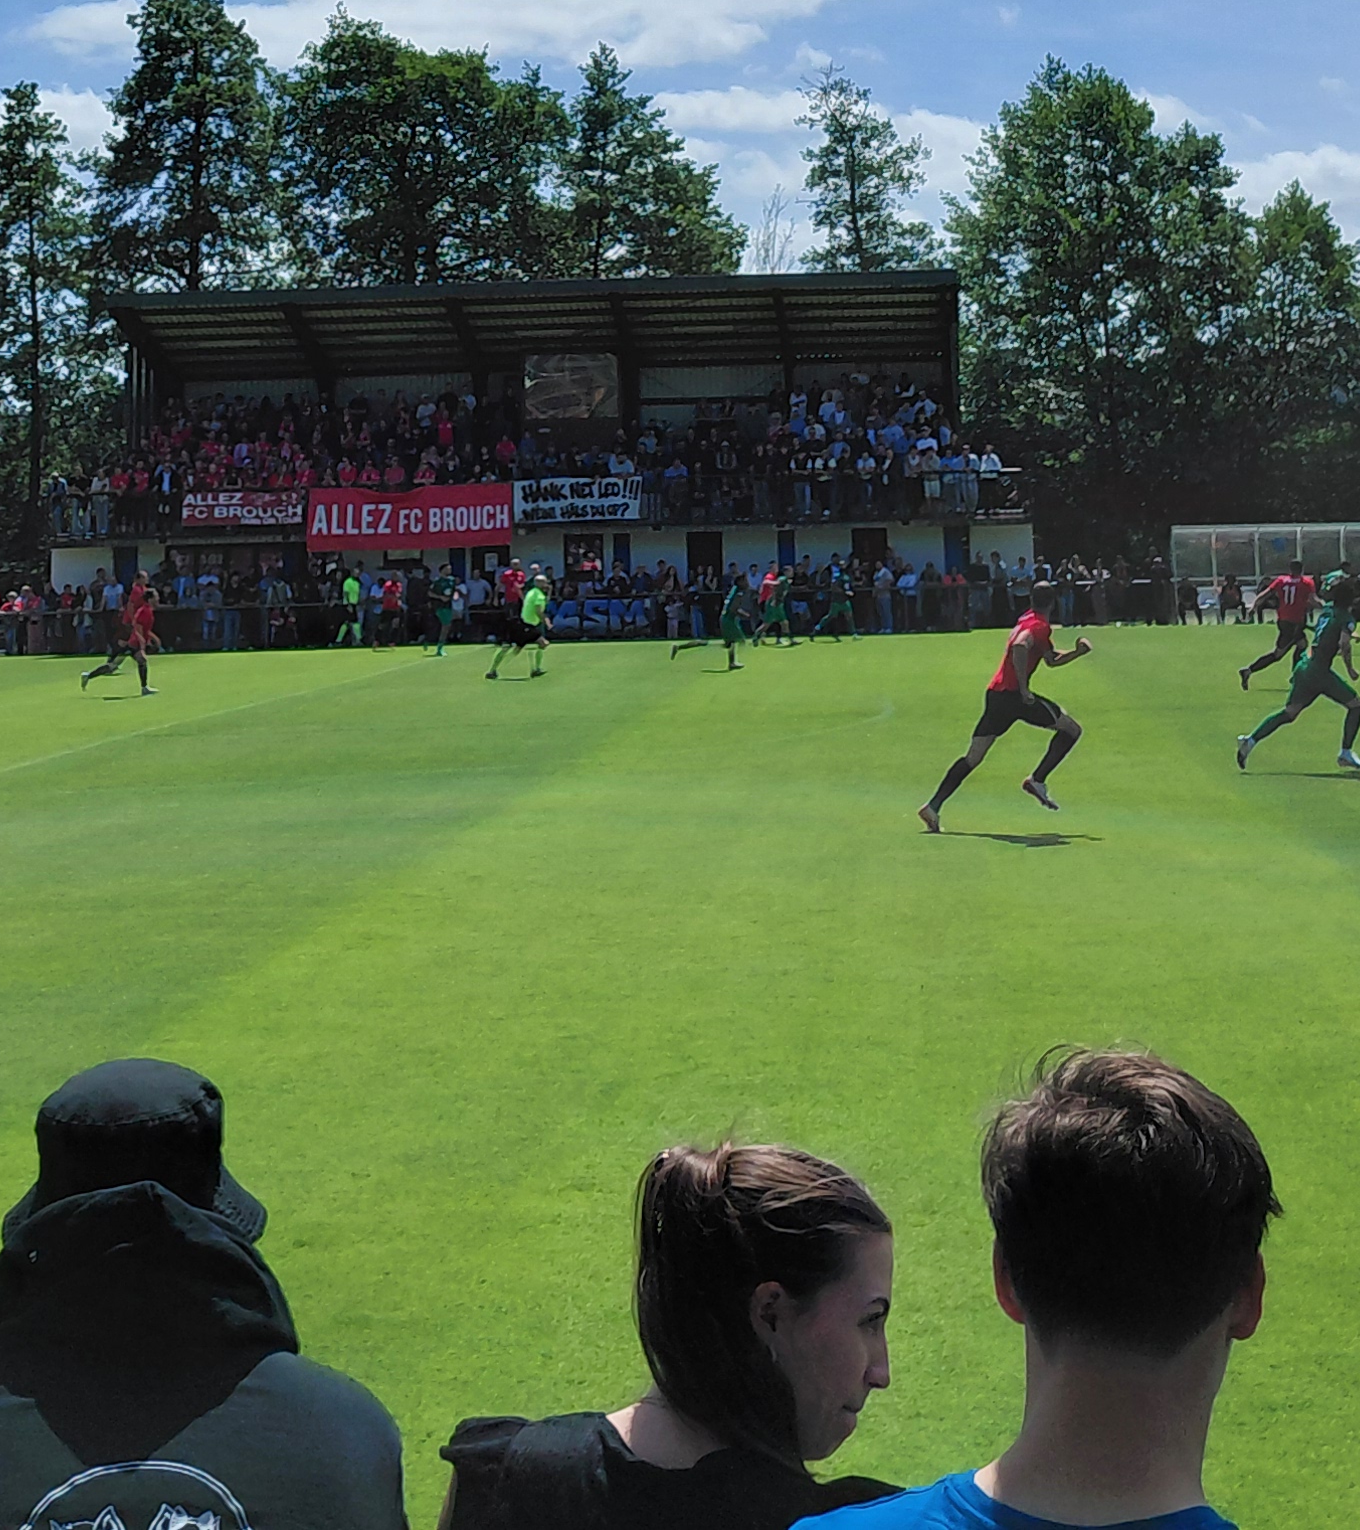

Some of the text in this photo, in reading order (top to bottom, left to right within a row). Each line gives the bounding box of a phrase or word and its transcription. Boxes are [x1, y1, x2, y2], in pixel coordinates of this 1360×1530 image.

[182, 492, 243, 505] ALLEZ
[182, 504, 302, 519] FC BROUCH
[311, 504, 509, 536] ALLEZ FC BROUCH
[1282, 584, 1296, 605] 11
